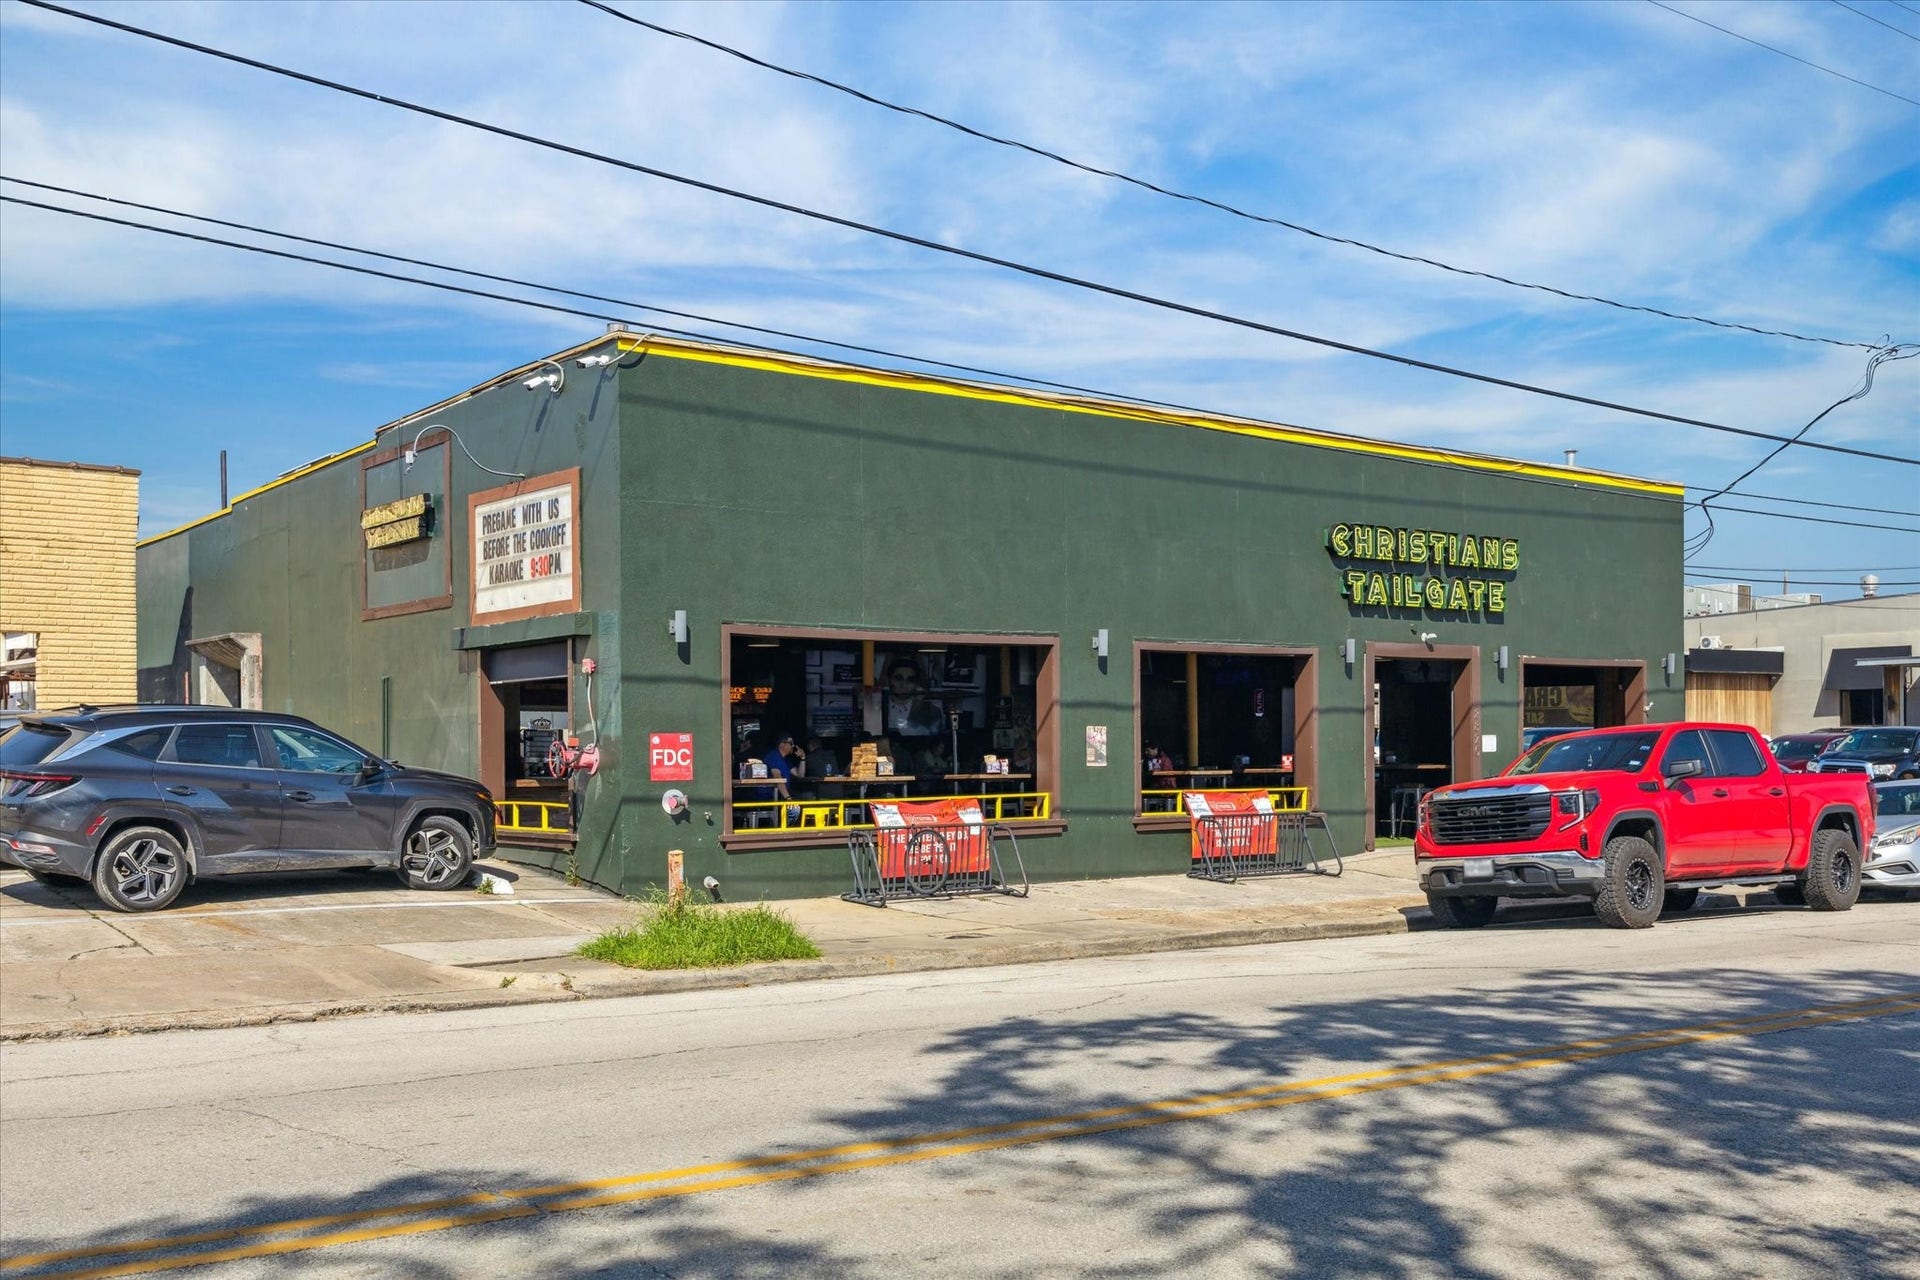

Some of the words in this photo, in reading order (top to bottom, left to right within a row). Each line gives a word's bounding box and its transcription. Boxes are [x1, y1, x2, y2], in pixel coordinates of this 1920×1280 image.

[482, 508, 516, 535] PREGAME
[522, 501, 542, 526] WITH
[548, 497, 560, 520] US
[483, 535, 510, 560] BEFORE
[513, 531, 527, 554] THE
[529, 523, 566, 550] COOKOFF
[1331, 523, 1520, 570] CHRISTIANS
[489, 560, 524, 585] KARAOKE
[530, 552, 562, 578] 9:30PM
[1347, 571, 1506, 612] TAILGATE
[652, 748, 691, 766] FDC
